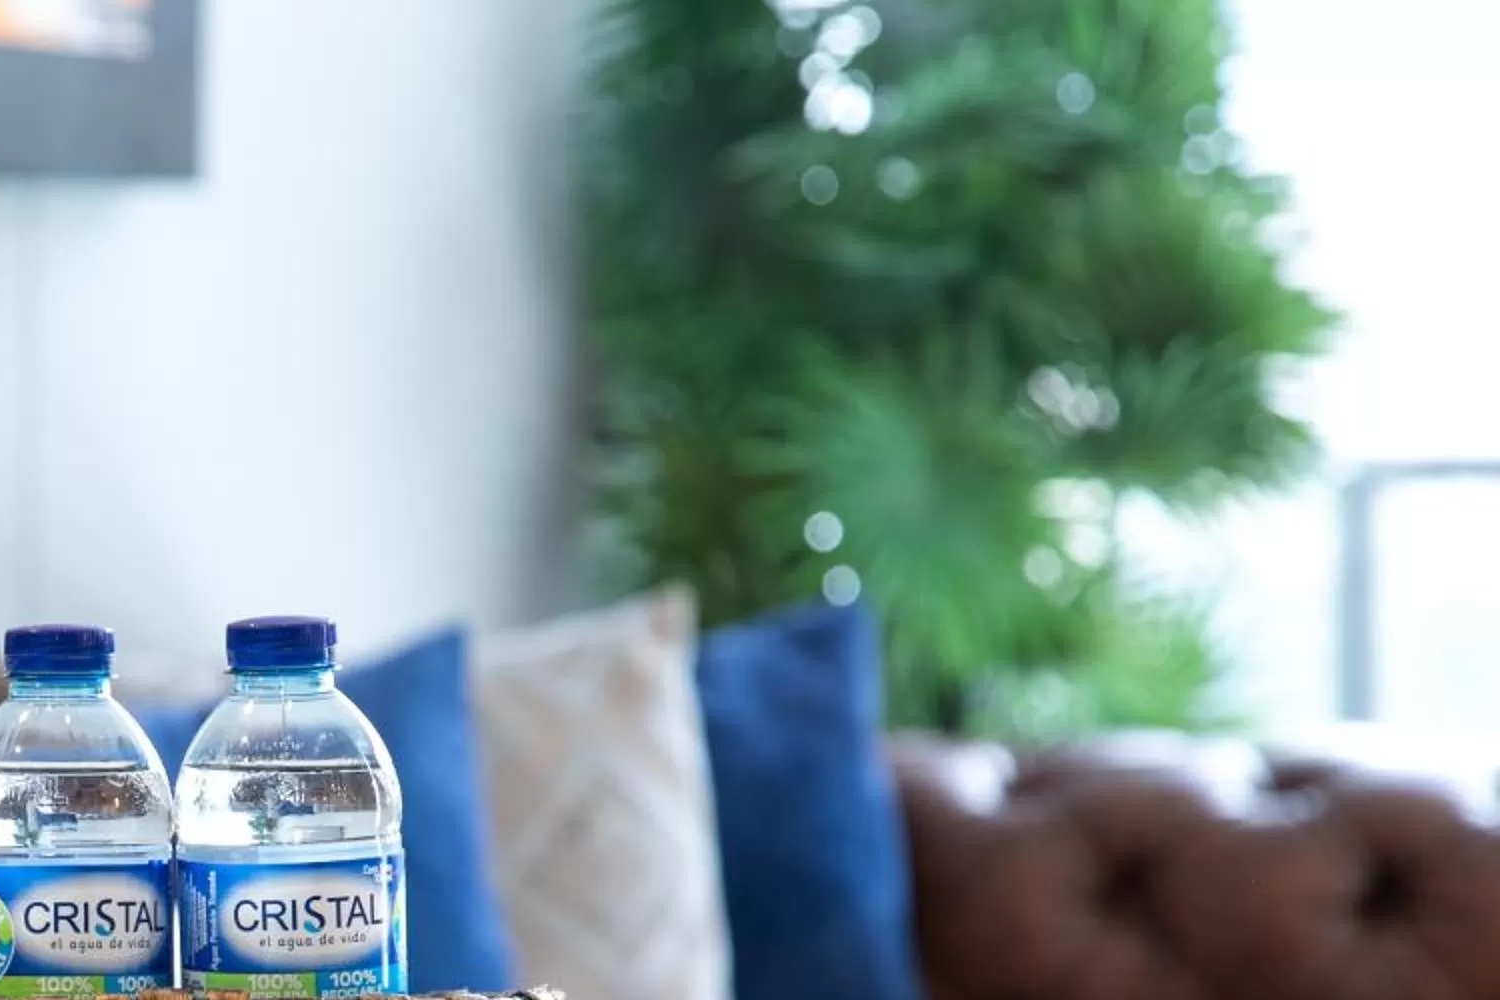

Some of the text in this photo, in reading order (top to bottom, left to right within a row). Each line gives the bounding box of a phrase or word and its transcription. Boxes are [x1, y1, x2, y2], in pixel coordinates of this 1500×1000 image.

[24, 897, 165, 937] CRISTAL
[233, 893, 384, 934] CRISTAL
[50, 937, 151, 954] el agua de vida
[259, 932, 366, 951] el agua de vida
[36, 976, 93, 993] 100%
[248, 974, 303, 991] 100%
[329, 969, 377, 988] 100%
